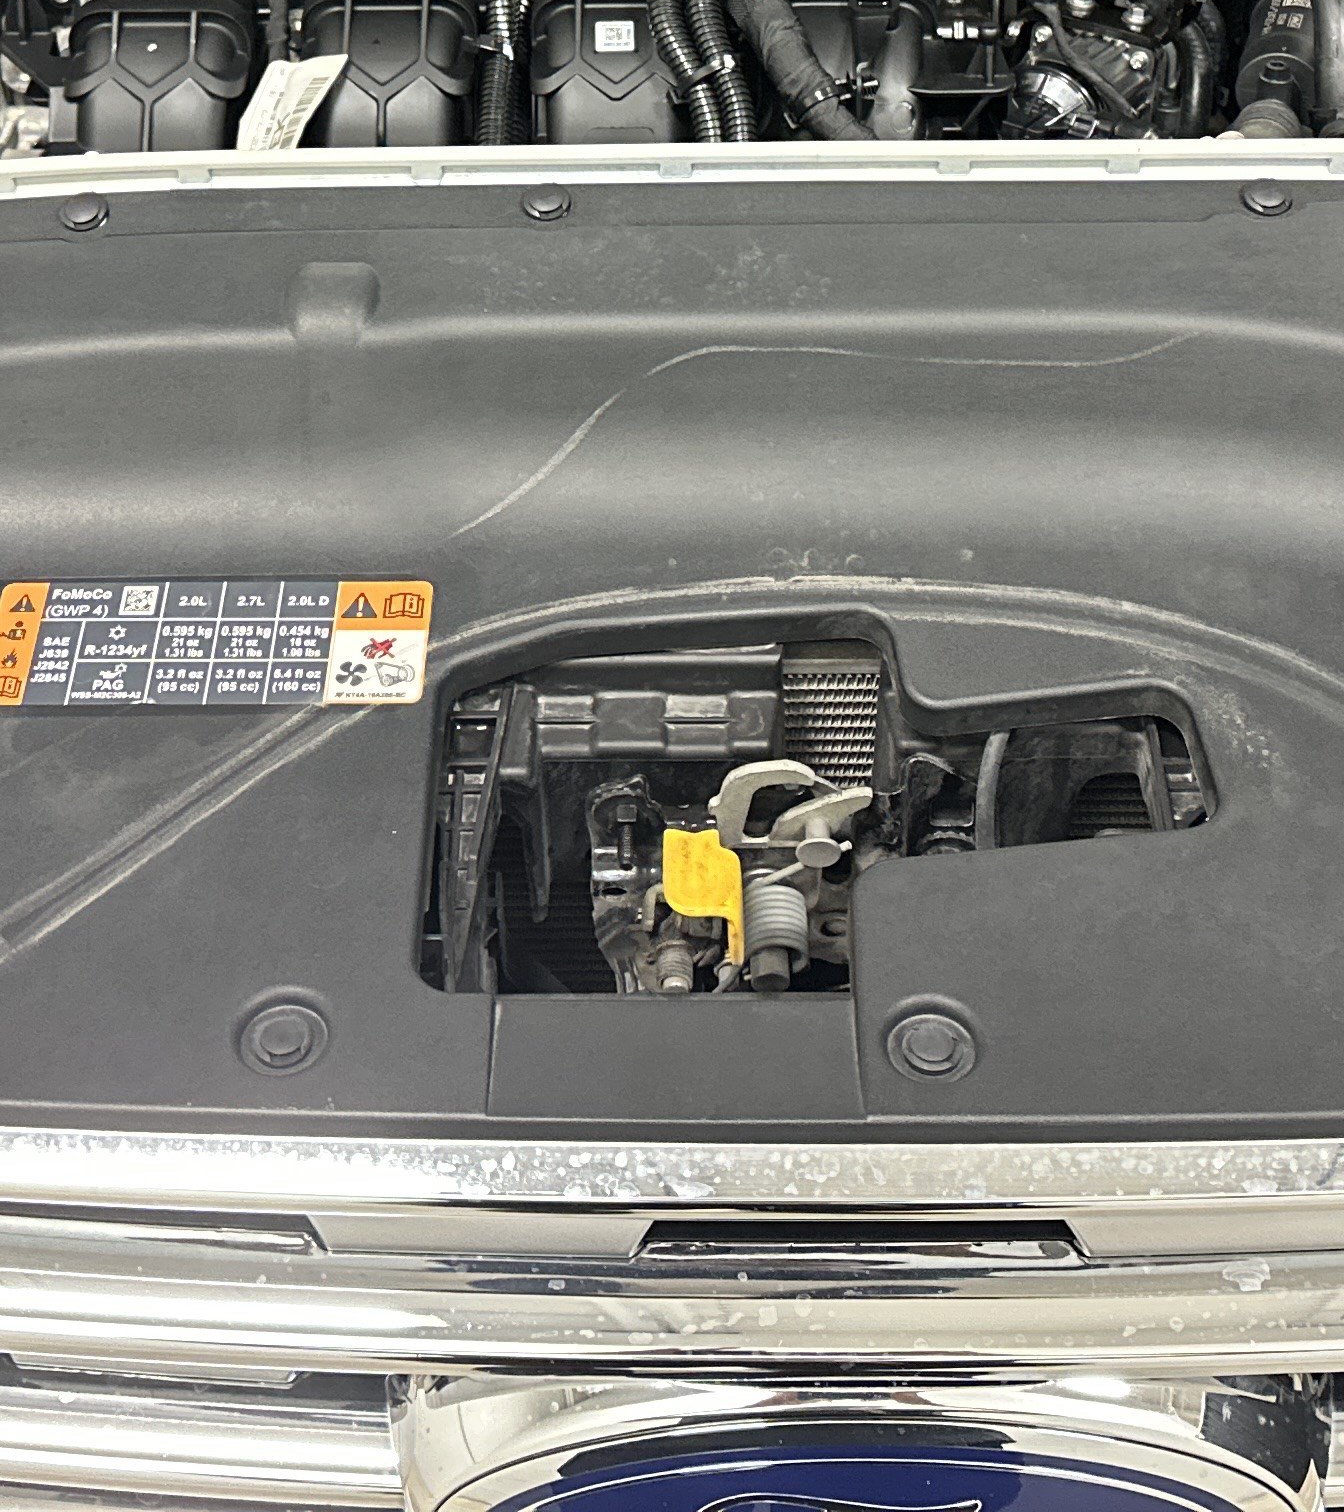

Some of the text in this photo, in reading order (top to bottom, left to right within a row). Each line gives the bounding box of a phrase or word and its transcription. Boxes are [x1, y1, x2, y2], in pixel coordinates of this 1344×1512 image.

[52, 588, 113, 600] FoMoCo
[179, 596, 207, 607] 2.0L
[237, 596, 265, 607] 2.7L
[288, 595, 330, 607] 2.0L D
[45, 605, 109, 618] (GWP 4)
[162, 626, 213, 639] 0.595 kg
[221, 626, 271, 639] 0.595 kg
[279, 626, 329, 639] 0.454 kg
[42, 637, 71, 647] SAE
[172, 638, 200, 647] 21 oz
[230, 638, 258, 647] 21 oz
[304, 639, 317, 647] oz
[84, 645, 148, 658] R-1234yf
[164, 648, 204, 658] 1.31 lbs
[223, 648, 263, 658] 1.31 lbs
[305, 648, 321, 658] lbs
[156, 669, 204, 679] 3.2 fl oz
[215, 669, 263, 679] 3.2 fl oz
[294, 669, 304, 679] fl
[306, 670, 321, 679] oz
[92, 680, 124, 691] PAG
[157, 681, 200, 693] (95 cc)
[217, 681, 259, 693] (95 cc)
[272, 681, 321, 693] (160 cc)
